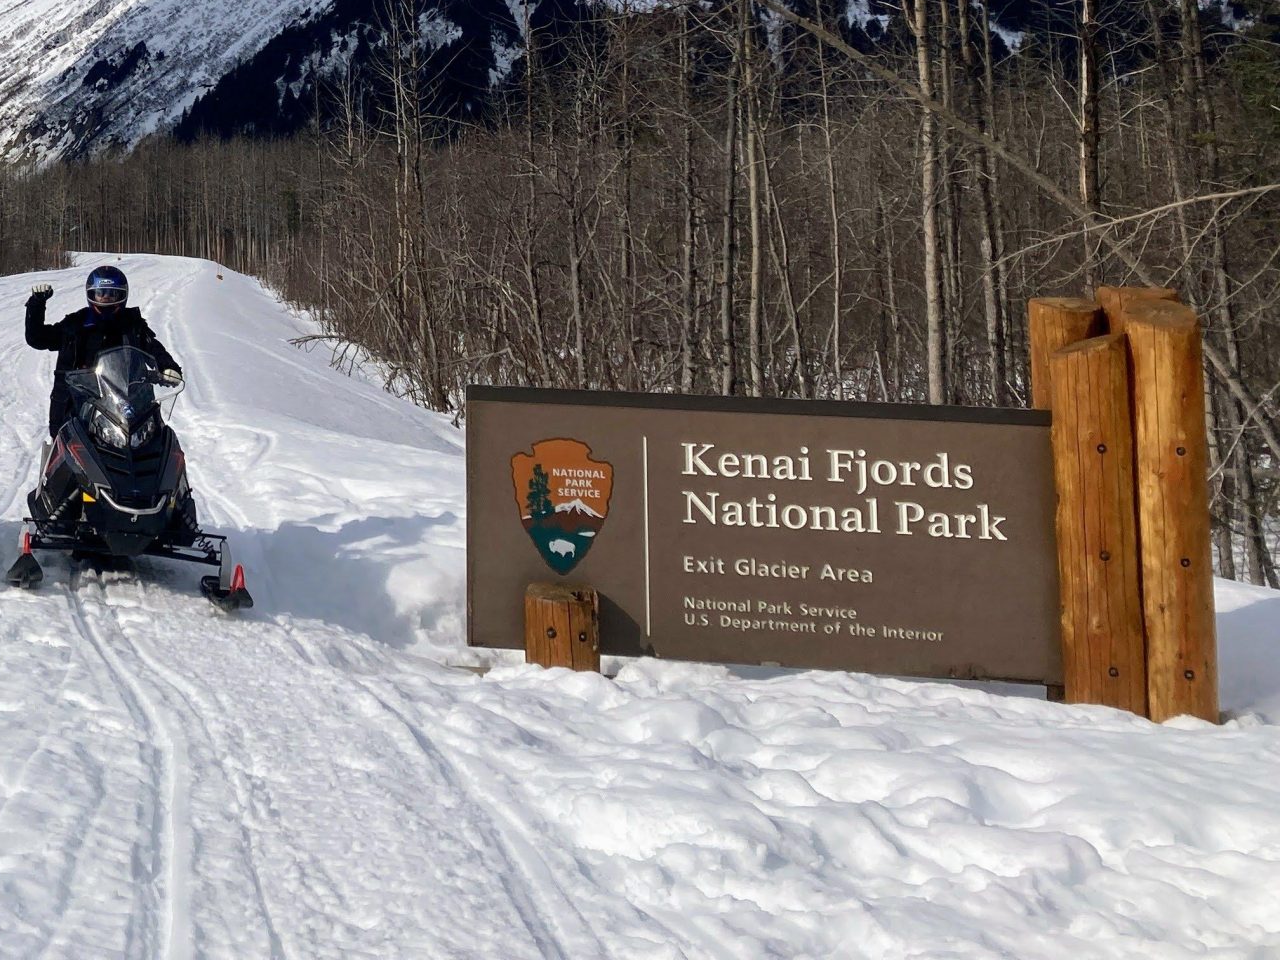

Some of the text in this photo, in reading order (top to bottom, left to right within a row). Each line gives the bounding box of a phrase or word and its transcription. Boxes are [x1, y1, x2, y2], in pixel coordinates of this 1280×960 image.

[552, 467, 606, 479] NATIONAL
[680, 442, 974, 495] Kenai Fjords
[558, 488, 601, 498] SERVICE
[565, 479, 593, 488] PARK
[681, 491, 1008, 541] National Park
[683, 555, 874, 583] Exit Glacier Area
[684, 596, 858, 620] National Park Service
[719, 614, 816, 633] Department
[823, 621, 841, 635] of
[849, 623, 876, 638] the
[882, 625, 945, 642] Interior
